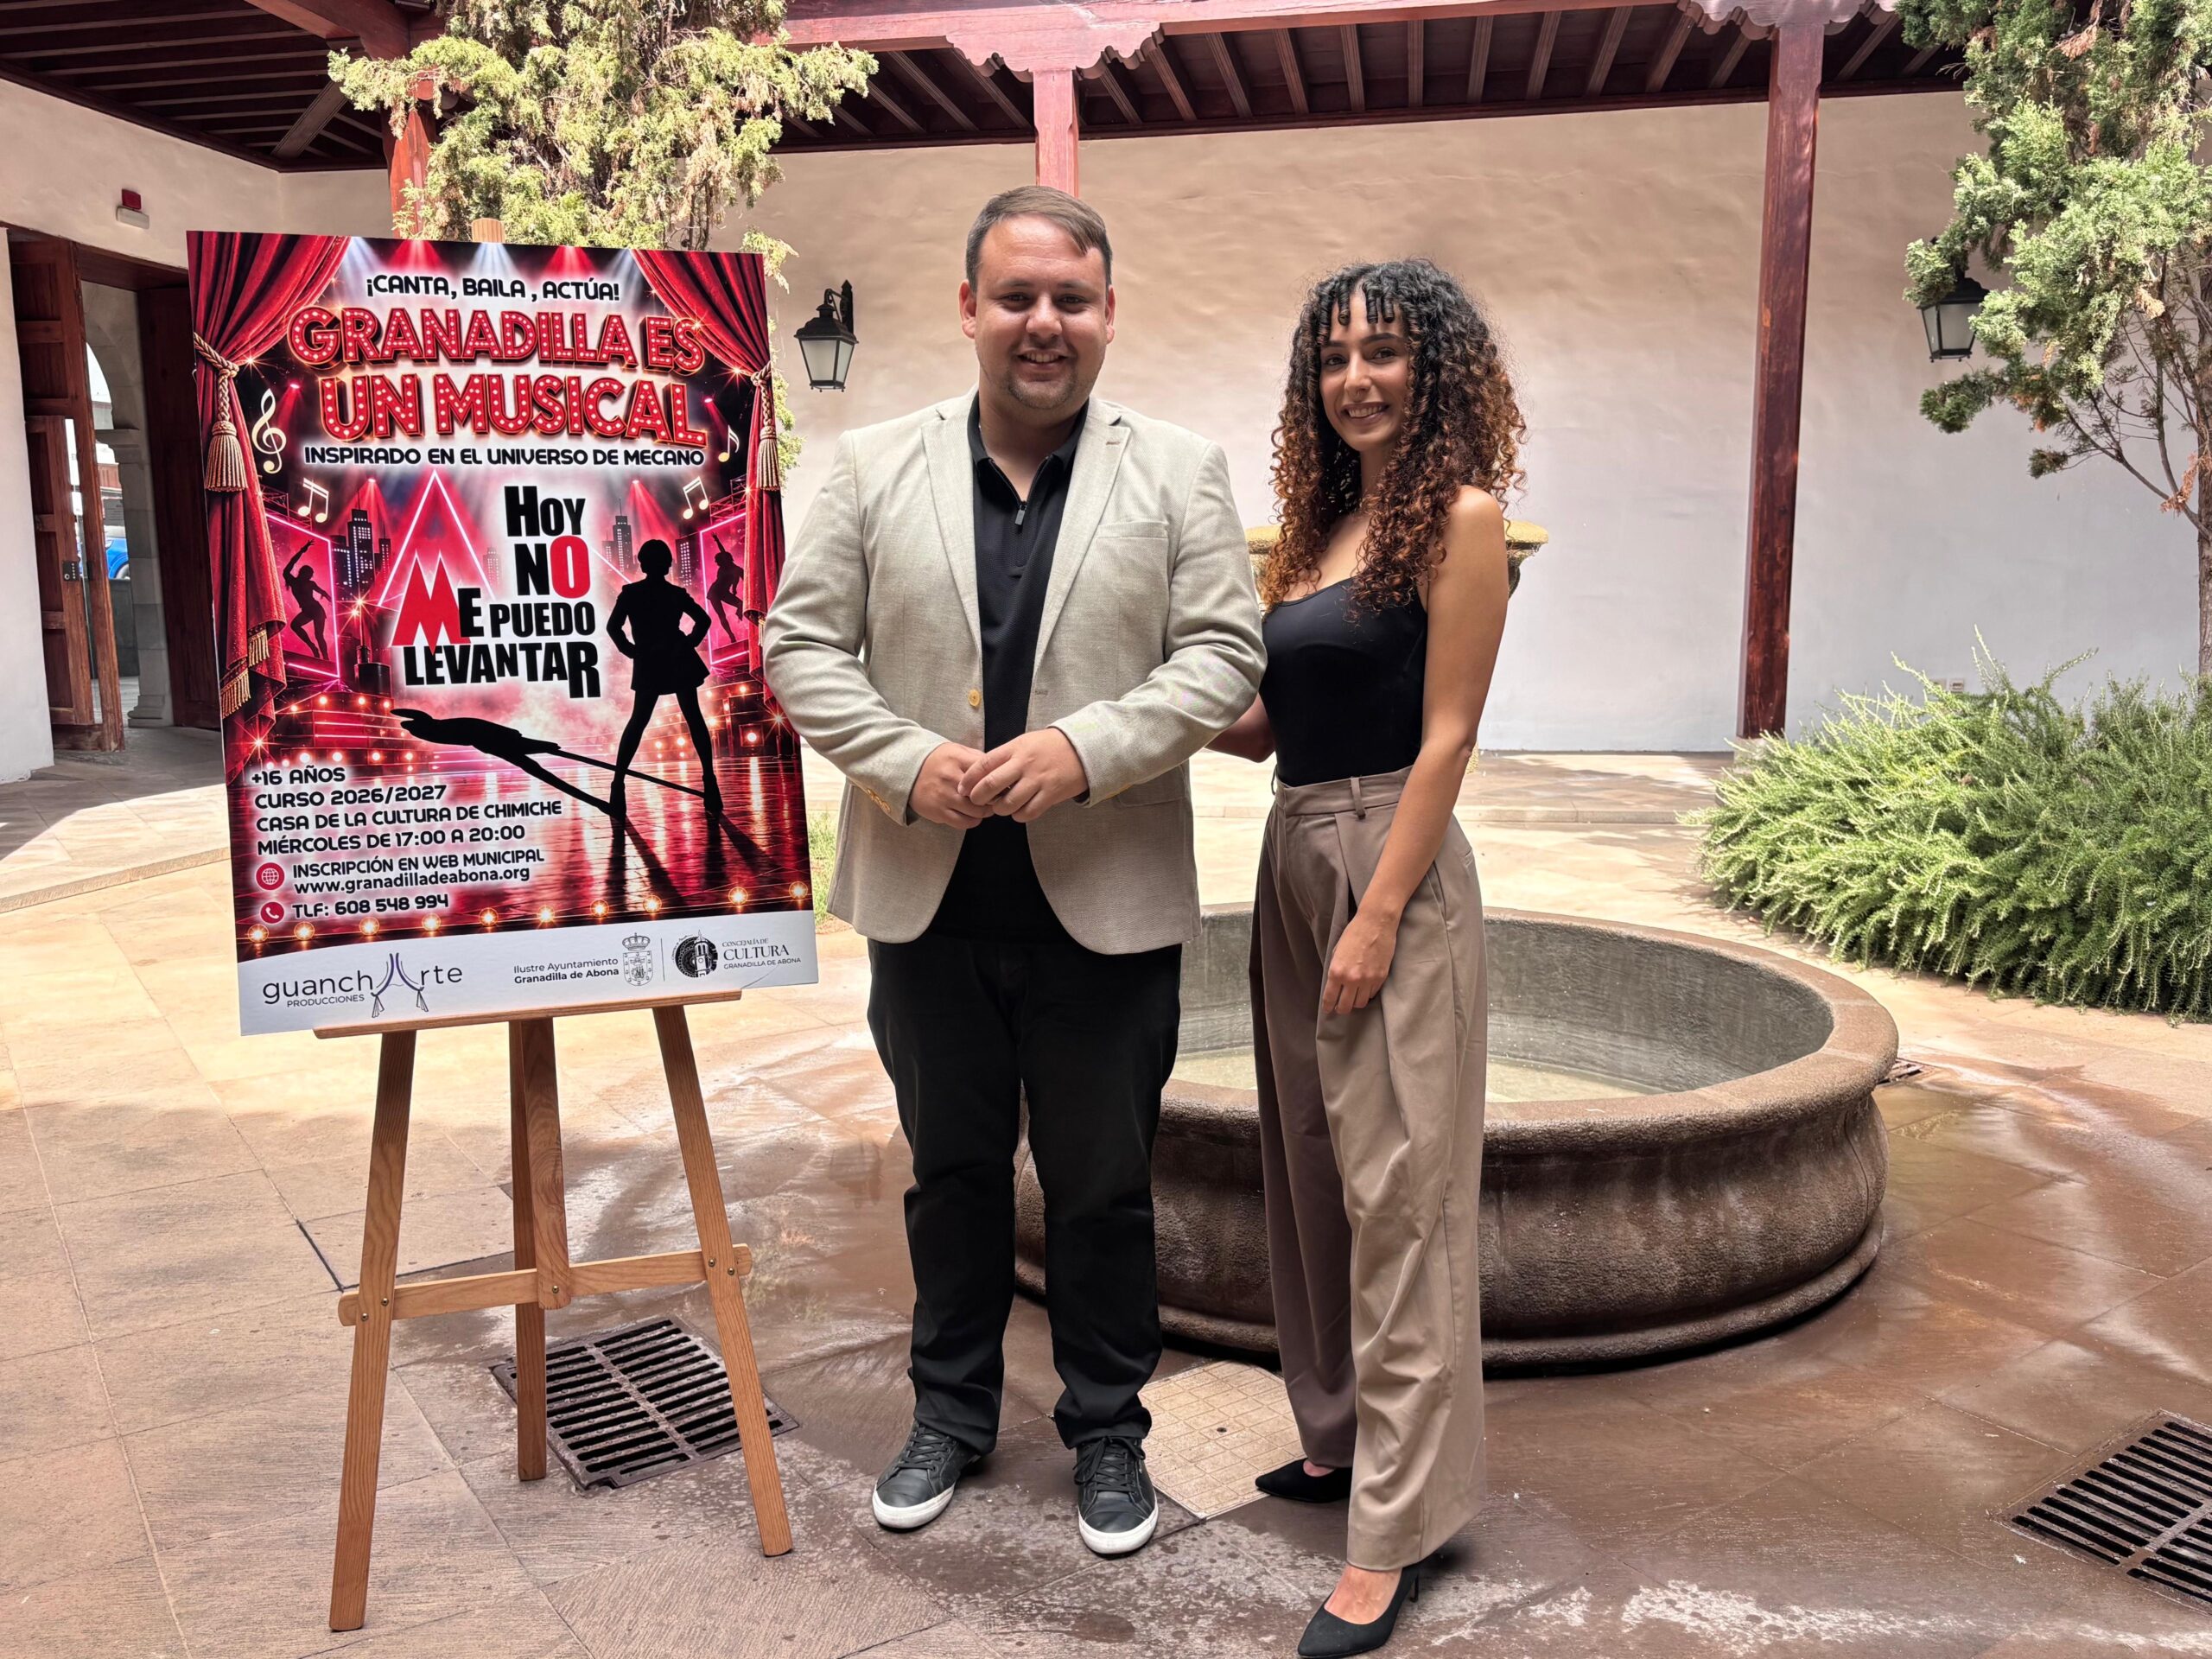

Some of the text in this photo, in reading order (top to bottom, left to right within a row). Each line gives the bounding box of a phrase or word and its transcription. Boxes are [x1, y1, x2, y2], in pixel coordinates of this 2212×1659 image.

[366, 274, 457, 300] ¡CANTA,
[543, 277, 620, 301] ACTÚA!
[287, 306, 705, 374] GRANADILLA ES
[319, 373, 708, 448] UN MUSICAL
[304, 447, 705, 466] INSPIRADO EN EL UNIVERSO DE MECANO
[513, 535, 591, 599] NO
[391, 555, 596, 655] ME PUEDO
[403, 641, 601, 698] LEVANTAR
[251, 765, 346, 786] +16 AÑOS
[254, 785, 448, 810] CURSO 2026/2027
[256, 800, 563, 832] CASA DE LA CULTURA DE CHIMICHE
[257, 825, 525, 855] MIÉRCOLES DE 17:00 A 20:00
[292, 849, 545, 879] INSCRIPCIÓN EN WEB MUNICIPAL
[294, 868, 530, 894] www.granadilladeabona.org
[292, 893, 449, 918] TLF: 608 548 994
[513, 957, 619, 974] Ilustre Ayuntamiento
[723, 944, 790, 961] CULTURA
[723, 960, 766, 969] GRANADILLA
[777, 957, 802, 965] ABONA
[514, 967, 620, 984] Granadilla de Abona
[286, 994, 365, 1008] PRODUCCIONES
